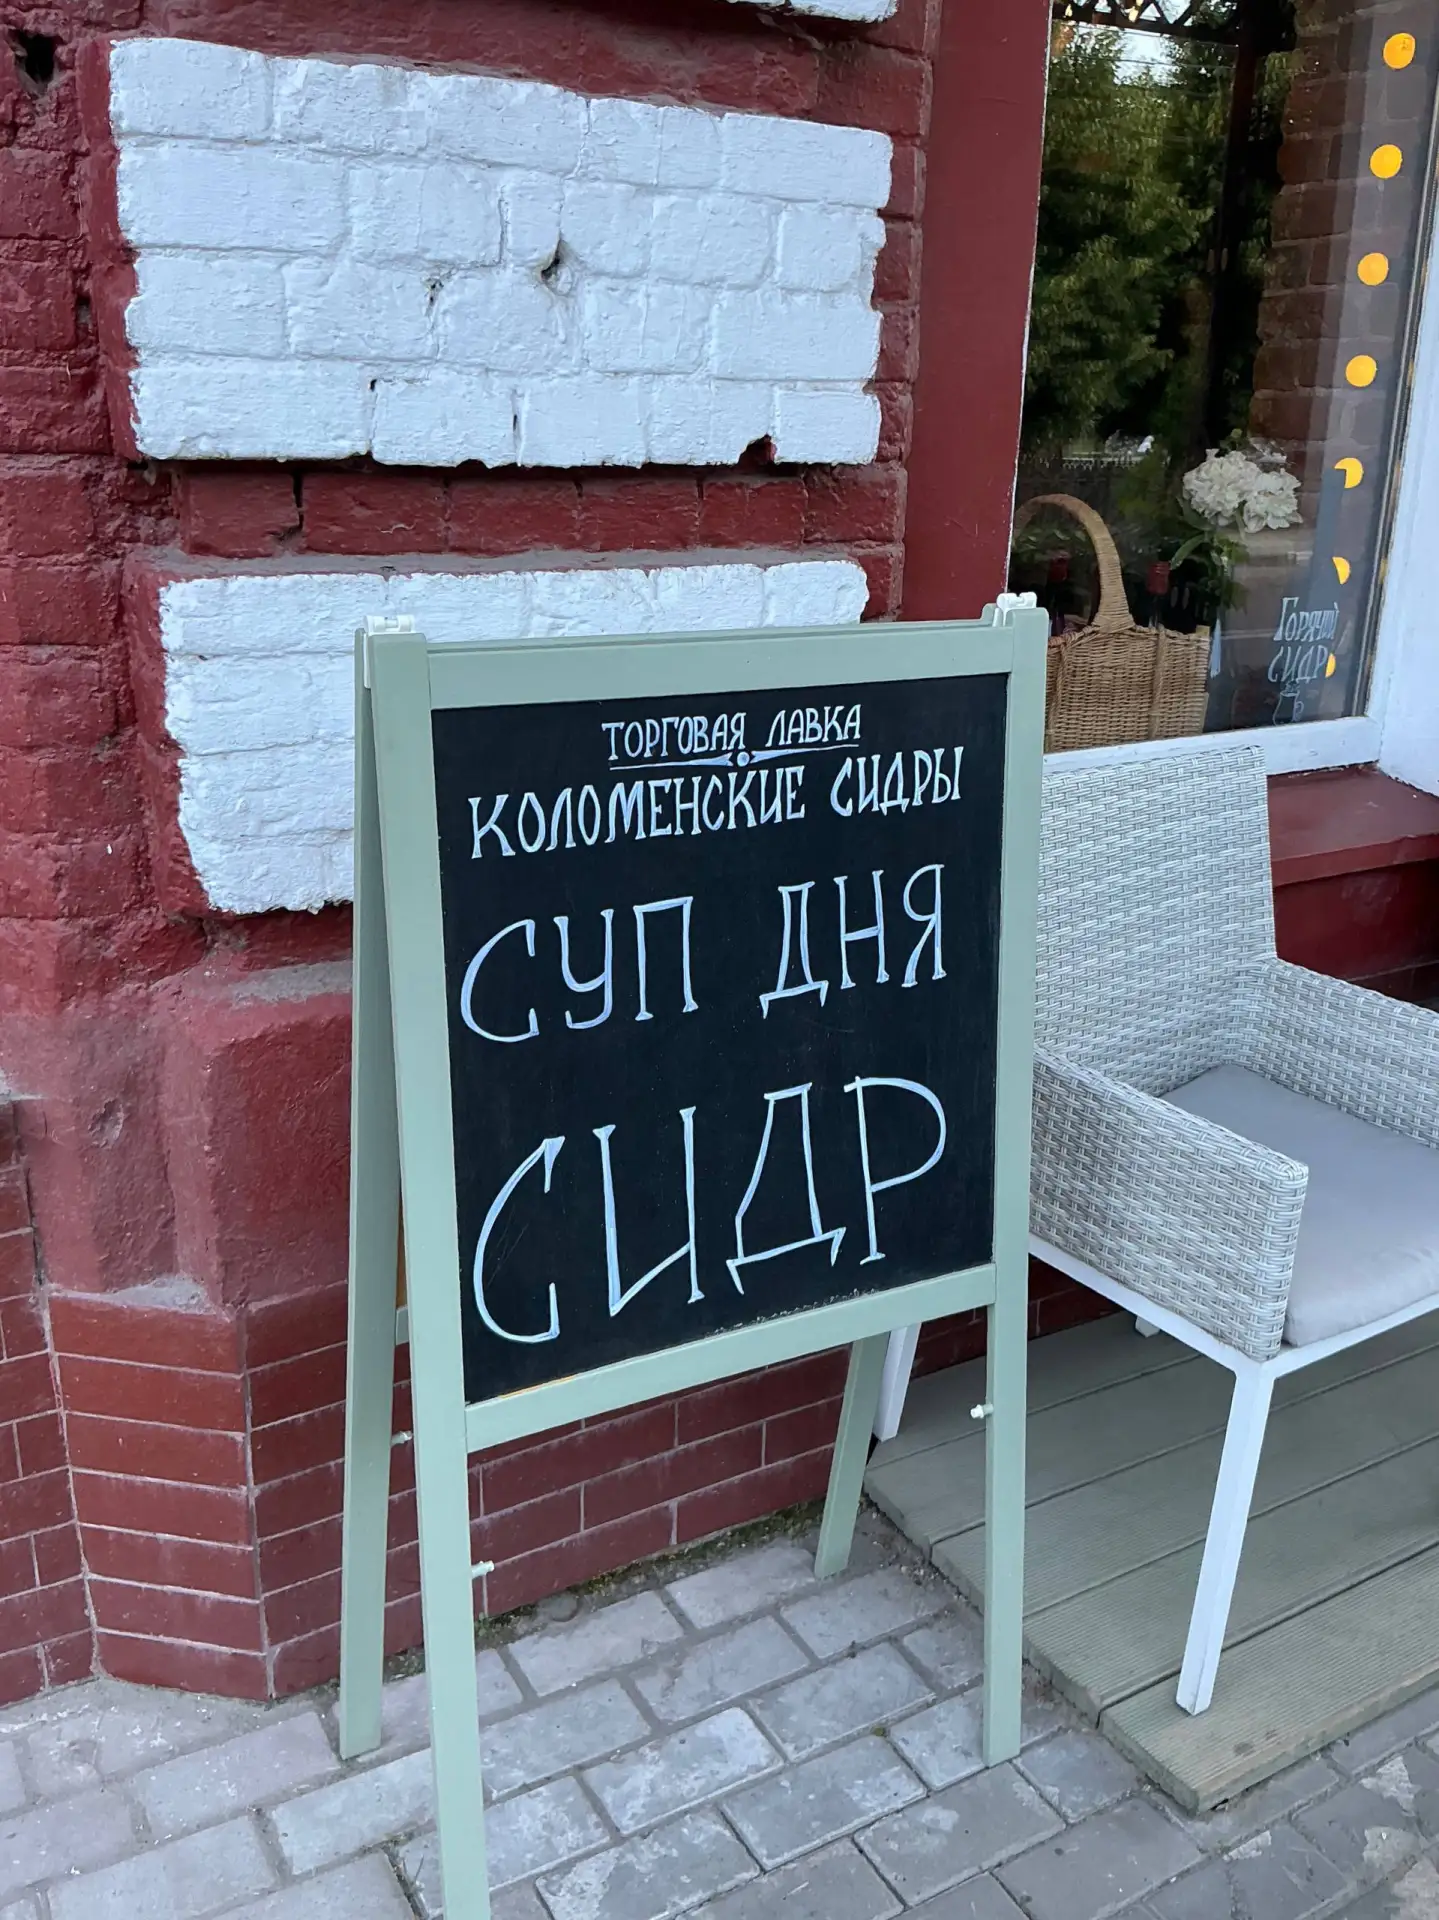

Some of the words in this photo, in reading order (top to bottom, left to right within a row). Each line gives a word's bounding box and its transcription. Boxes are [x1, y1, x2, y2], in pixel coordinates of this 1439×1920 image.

[467, 764, 806, 860] КОЛОМЕНСКИЕ
[830, 745, 966, 817] СИДРЫ
[601, 711, 747, 761] ТОРГОВАЯ
[764, 703, 862, 748] ЛАВКА
[460, 895, 699, 1043] СУП
[758, 863, 948, 1021] ДНЯ
[472, 1075, 948, 1344] СИДР
